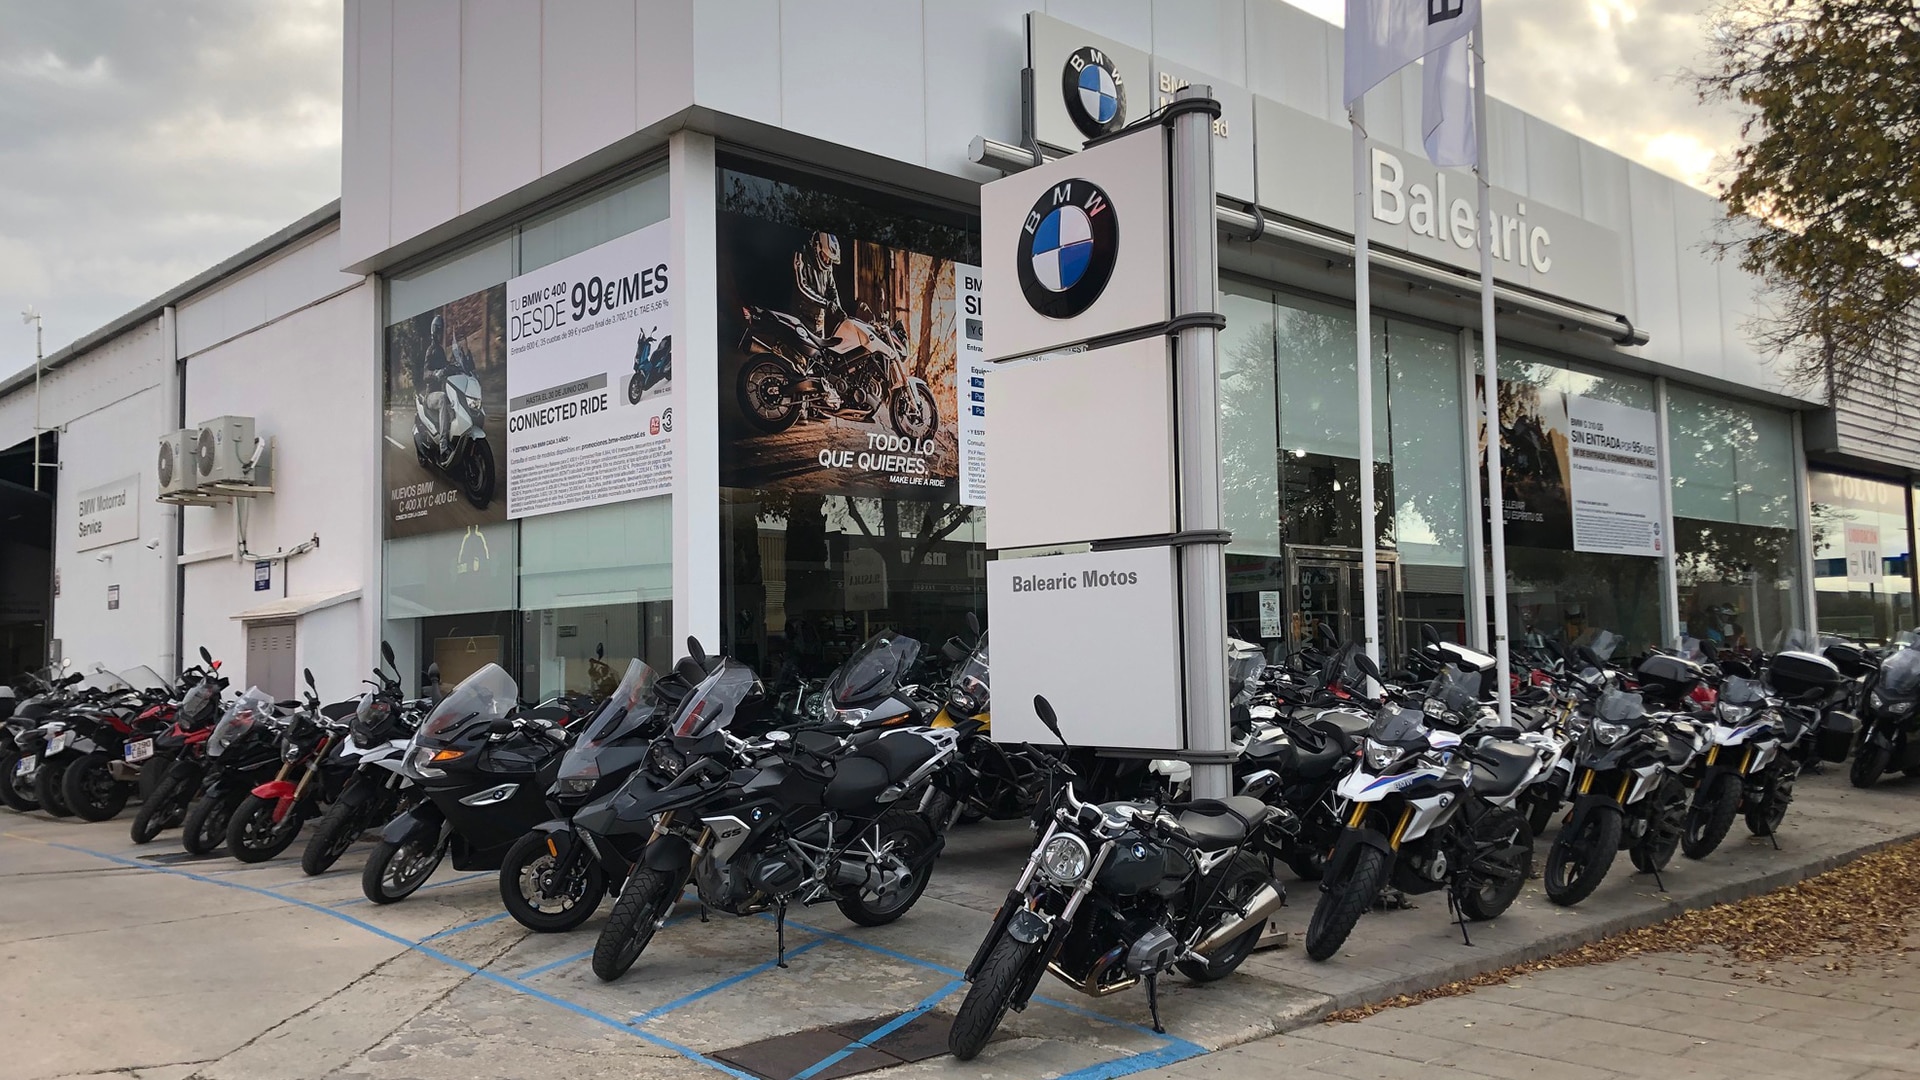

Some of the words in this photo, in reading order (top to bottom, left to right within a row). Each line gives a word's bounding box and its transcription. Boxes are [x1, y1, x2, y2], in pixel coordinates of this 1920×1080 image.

[965, 276, 982, 292] BM
[510, 299, 521, 313] TU
[522, 289, 542, 308] BMW
[543, 287, 550, 300] C
[551, 281, 566, 298] 400
[511, 298, 566, 342] DESDE
[571, 263, 668, 322] 99€/MES
[965, 295, 981, 315] SI
[546, 331, 560, 344] cuotas
[561, 329, 566, 339] de
[581, 320, 594, 333] cuota
[595, 317, 604, 329] final
[605, 315, 610, 325] de
[639, 302, 649, 314] TAE
[526, 394, 541, 405] HASTA
[542, 392, 546, 400] EL
[549, 390, 553, 399] 30
[555, 388, 560, 397] DE
[562, 384, 576, 395] JUNIO
[577, 381, 588, 391] CON
[510, 402, 577, 433] CONNECTED
[580, 394, 607, 416] RIDE
[666, 413, 671, 426] 3
[867, 433, 911, 453] TODO
[915, 438, 935, 456] LO
[1571, 430, 1584, 443] SIN
[1586, 433, 1621, 450] ENTRADA
[818, 450, 854, 468] QUE
[858, 452, 929, 475] QUIERES.
[392, 485, 416, 500] NUEVOS
[417, 481, 434, 495] BMW
[889, 475, 908, 484] MAKE
[910, 477, 922, 485] LIFE
[929, 479, 946, 487] RIDE.
[1829, 474, 1888, 504] VOLVO
[80, 498, 95, 517] BMW
[97, 489, 125, 511] Motorrad
[400, 501, 404, 512] C
[405, 498, 416, 511] 400
[428, 495, 433, 506] C
[434, 492, 447, 506] 400
[79, 519, 102, 537] Service
[1012, 572, 1077, 592] Balearic
[1082, 570, 1137, 588] Motos
[1301, 571, 1313, 648] Motos
[721, 827, 741, 838] GS
